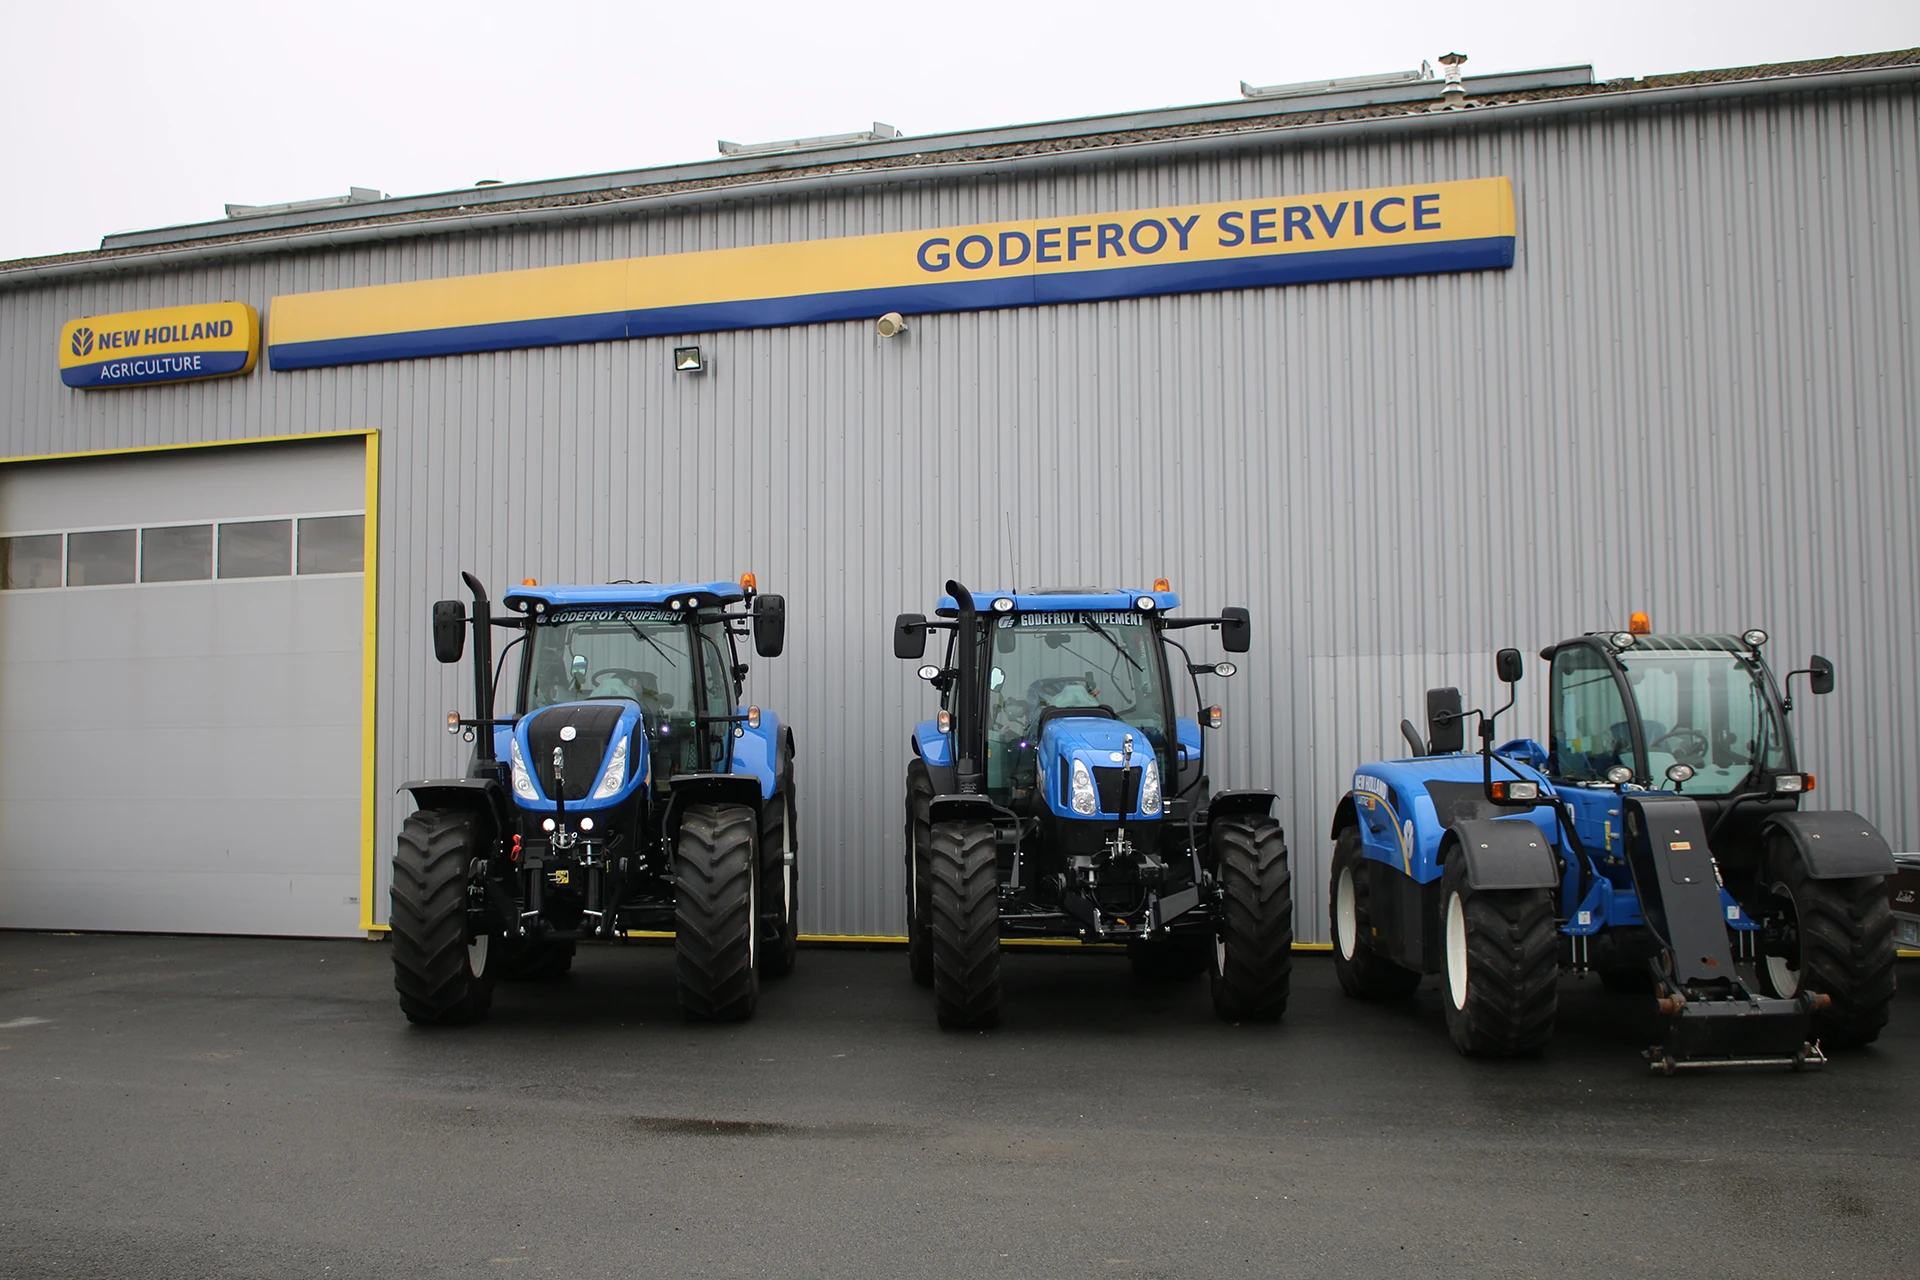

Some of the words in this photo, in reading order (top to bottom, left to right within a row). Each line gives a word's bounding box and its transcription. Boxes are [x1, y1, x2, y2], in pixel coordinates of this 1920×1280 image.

[916, 214, 1201, 272] GODEFROY
[1217, 193, 1441, 248] SERVICE
[98, 328, 140, 350] NEW
[144, 319, 233, 345] HOLLAND
[100, 355, 201, 379] AGRICULTURE
[551, 610, 616, 623] GODEFROY
[617, 610, 685, 621] EQUIPEMENT
[1021, 613, 1075, 626] GODEFROY
